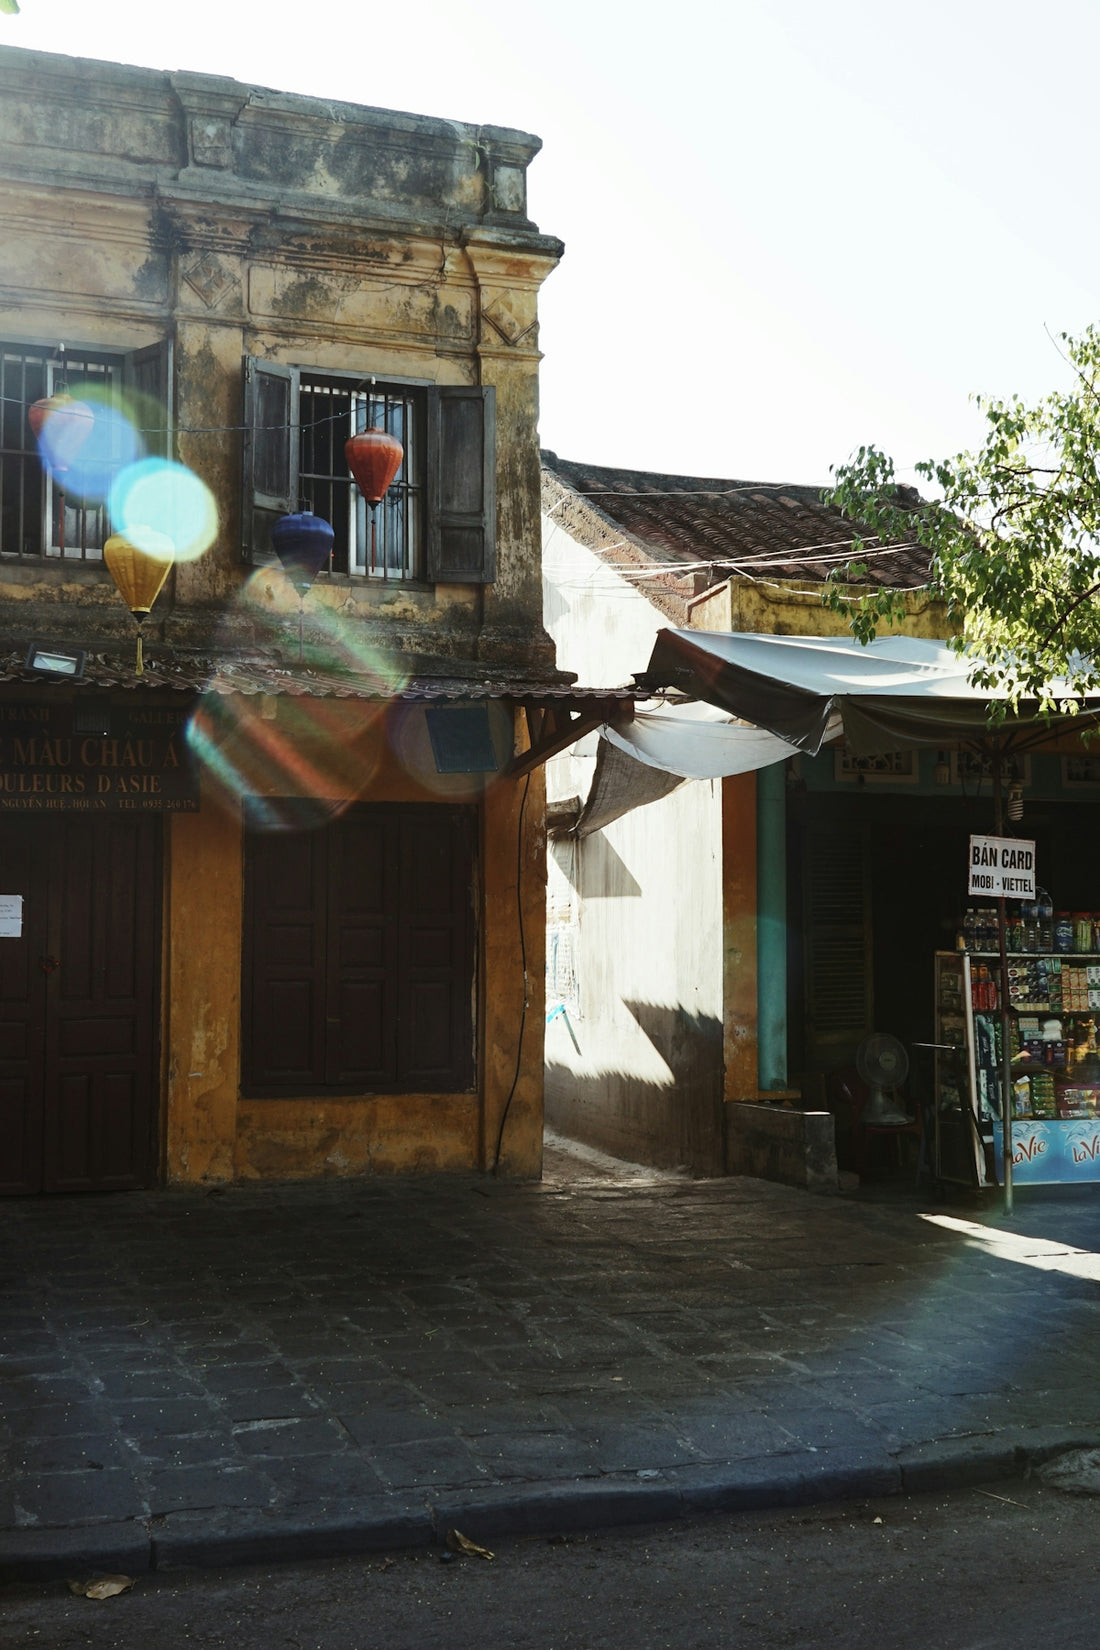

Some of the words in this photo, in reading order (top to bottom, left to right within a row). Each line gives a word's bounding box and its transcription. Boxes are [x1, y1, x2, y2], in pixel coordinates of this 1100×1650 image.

[12, 729, 72, 767] MÀU
[80, 731, 155, 767] CHÂU
[162, 730, 180, 768] Á
[972, 842, 998, 867] BÁN
[1001, 848, 1033, 870] CARD
[972, 874, 994, 889] MOBI
[1002, 876, 1033, 893] VIETTEL
